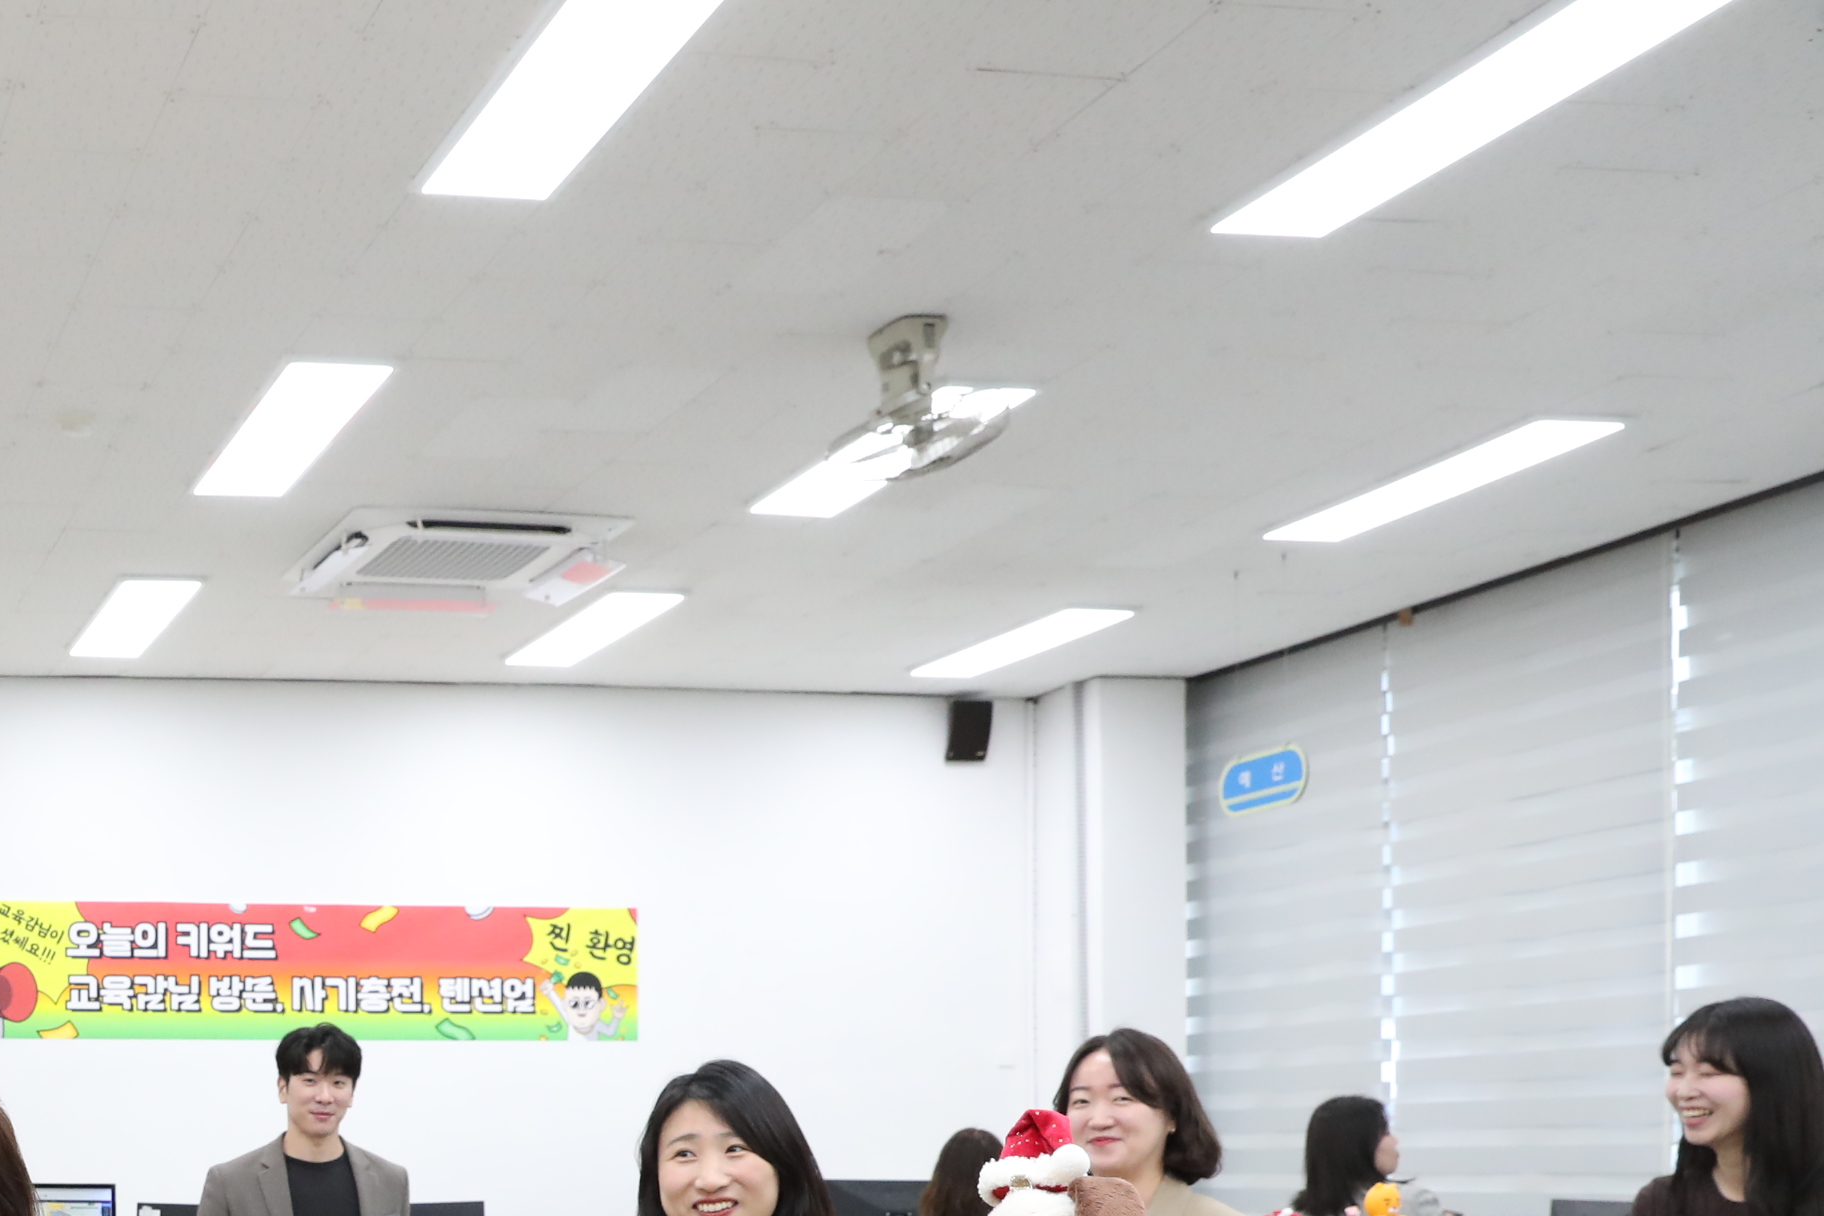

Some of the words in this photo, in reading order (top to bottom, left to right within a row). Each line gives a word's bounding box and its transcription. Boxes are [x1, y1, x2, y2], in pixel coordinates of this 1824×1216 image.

[65, 921, 168, 959] 오늘의
[176, 922, 278, 960] 키워드
[547, 923, 571, 953] 찐
[586, 929, 636, 966] 환영
[65, 974, 201, 1013] 교육감님
[208, 975, 285, 1014] 방문,
[291, 976, 431, 1014] 사기충전,
[438, 977, 536, 1014] 텐션업
